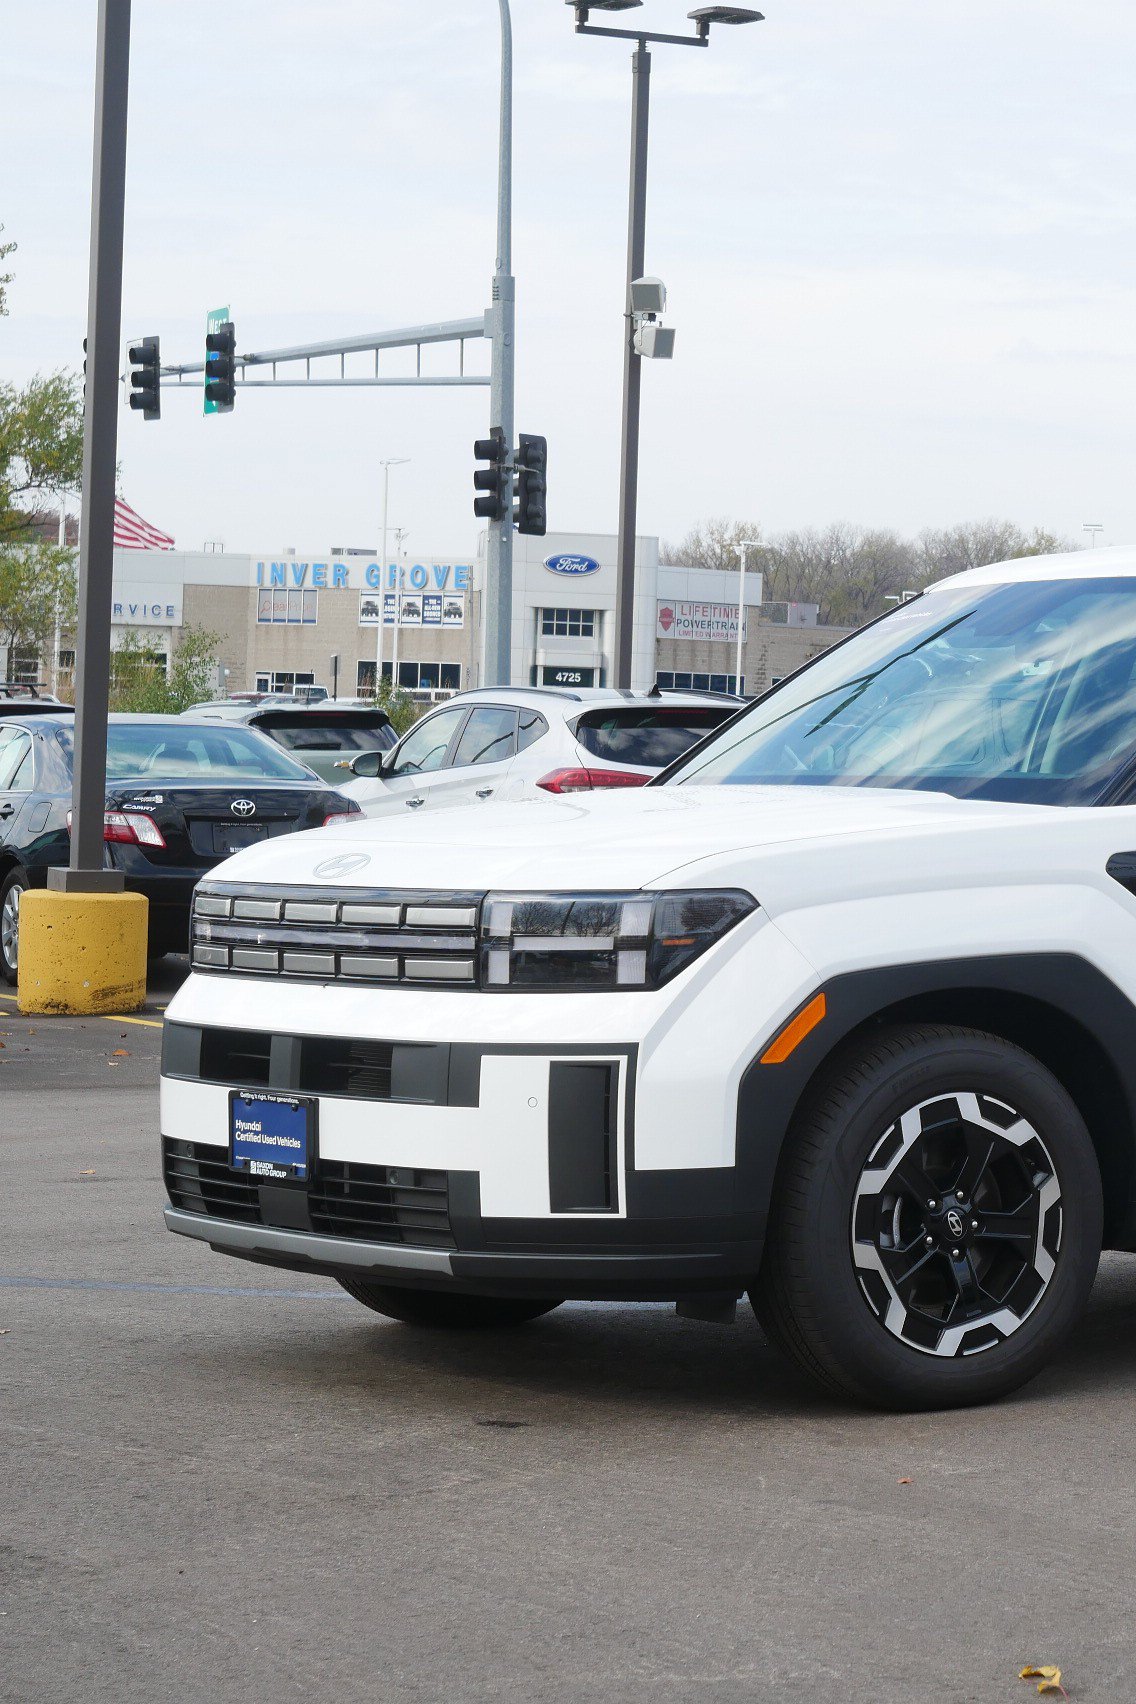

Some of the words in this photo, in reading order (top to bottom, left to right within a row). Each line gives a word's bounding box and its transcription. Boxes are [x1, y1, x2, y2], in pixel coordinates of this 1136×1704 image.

[556, 557, 588, 572] Ford
[257, 562, 348, 587] INVER
[365, 563, 469, 590] GROVE
[113, 603, 175, 617] RVICE
[681, 604, 740, 620] LIFETIME
[676, 618, 746, 632] POWERTRAIN
[704, 631, 740, 639] WARRANT
[555, 672, 581, 683] 4725
[235, 1119, 262, 1131] Hyundai
[235, 1131, 261, 1143] Certified
[261, 1134, 277, 1145] Used
[276, 1136, 301, 1149] Vehicles
[256, 1168, 270, 1176] AUTO
[269, 1169, 287, 1179] GROUP
